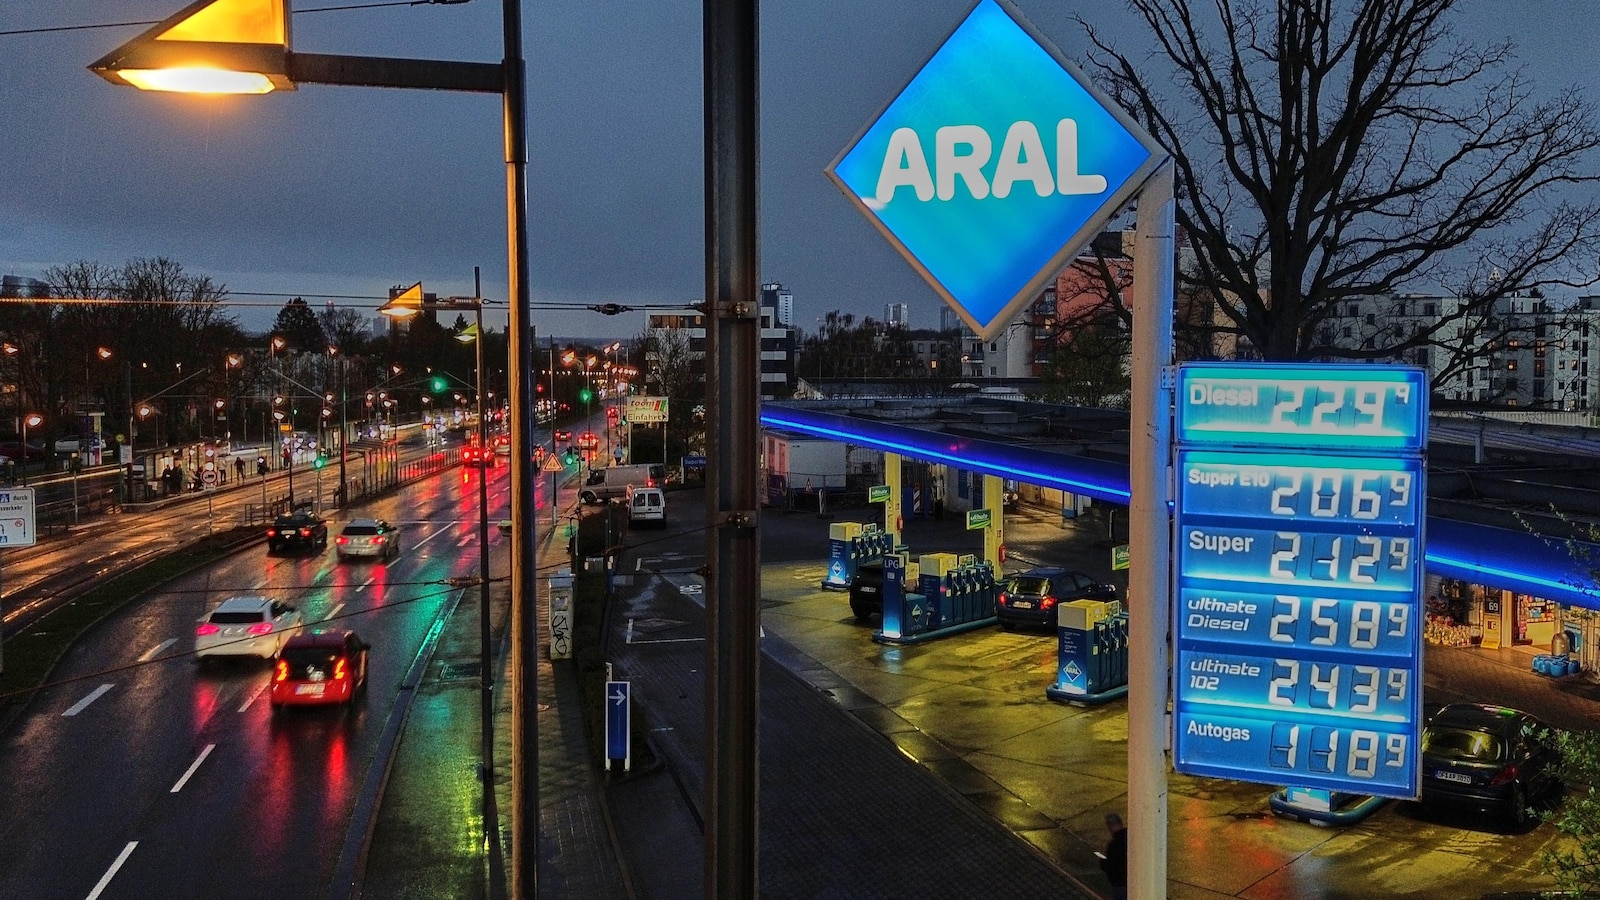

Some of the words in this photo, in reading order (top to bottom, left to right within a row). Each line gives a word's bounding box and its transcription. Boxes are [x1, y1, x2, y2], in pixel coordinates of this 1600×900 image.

[876, 118, 1107, 203] ARAL
[630, 399, 655, 407] toom
[1190, 384, 1259, 406] Diesel
[628, 413, 661, 421] Einfahrt
[1188, 468, 1238, 488] Super
[1239, 471, 1270, 487] E10
[1189, 531, 1255, 555] Super
[884, 559, 899, 569] LPG
[1187, 597, 1258, 615] ultimate
[1488, 602, 1499, 611] 69
[1187, 613, 1250, 632] Diesel
[1190, 658, 1261, 678] ultimate
[1189, 675, 1220, 691] 102
[1187, 720, 1251, 742] Autogas
